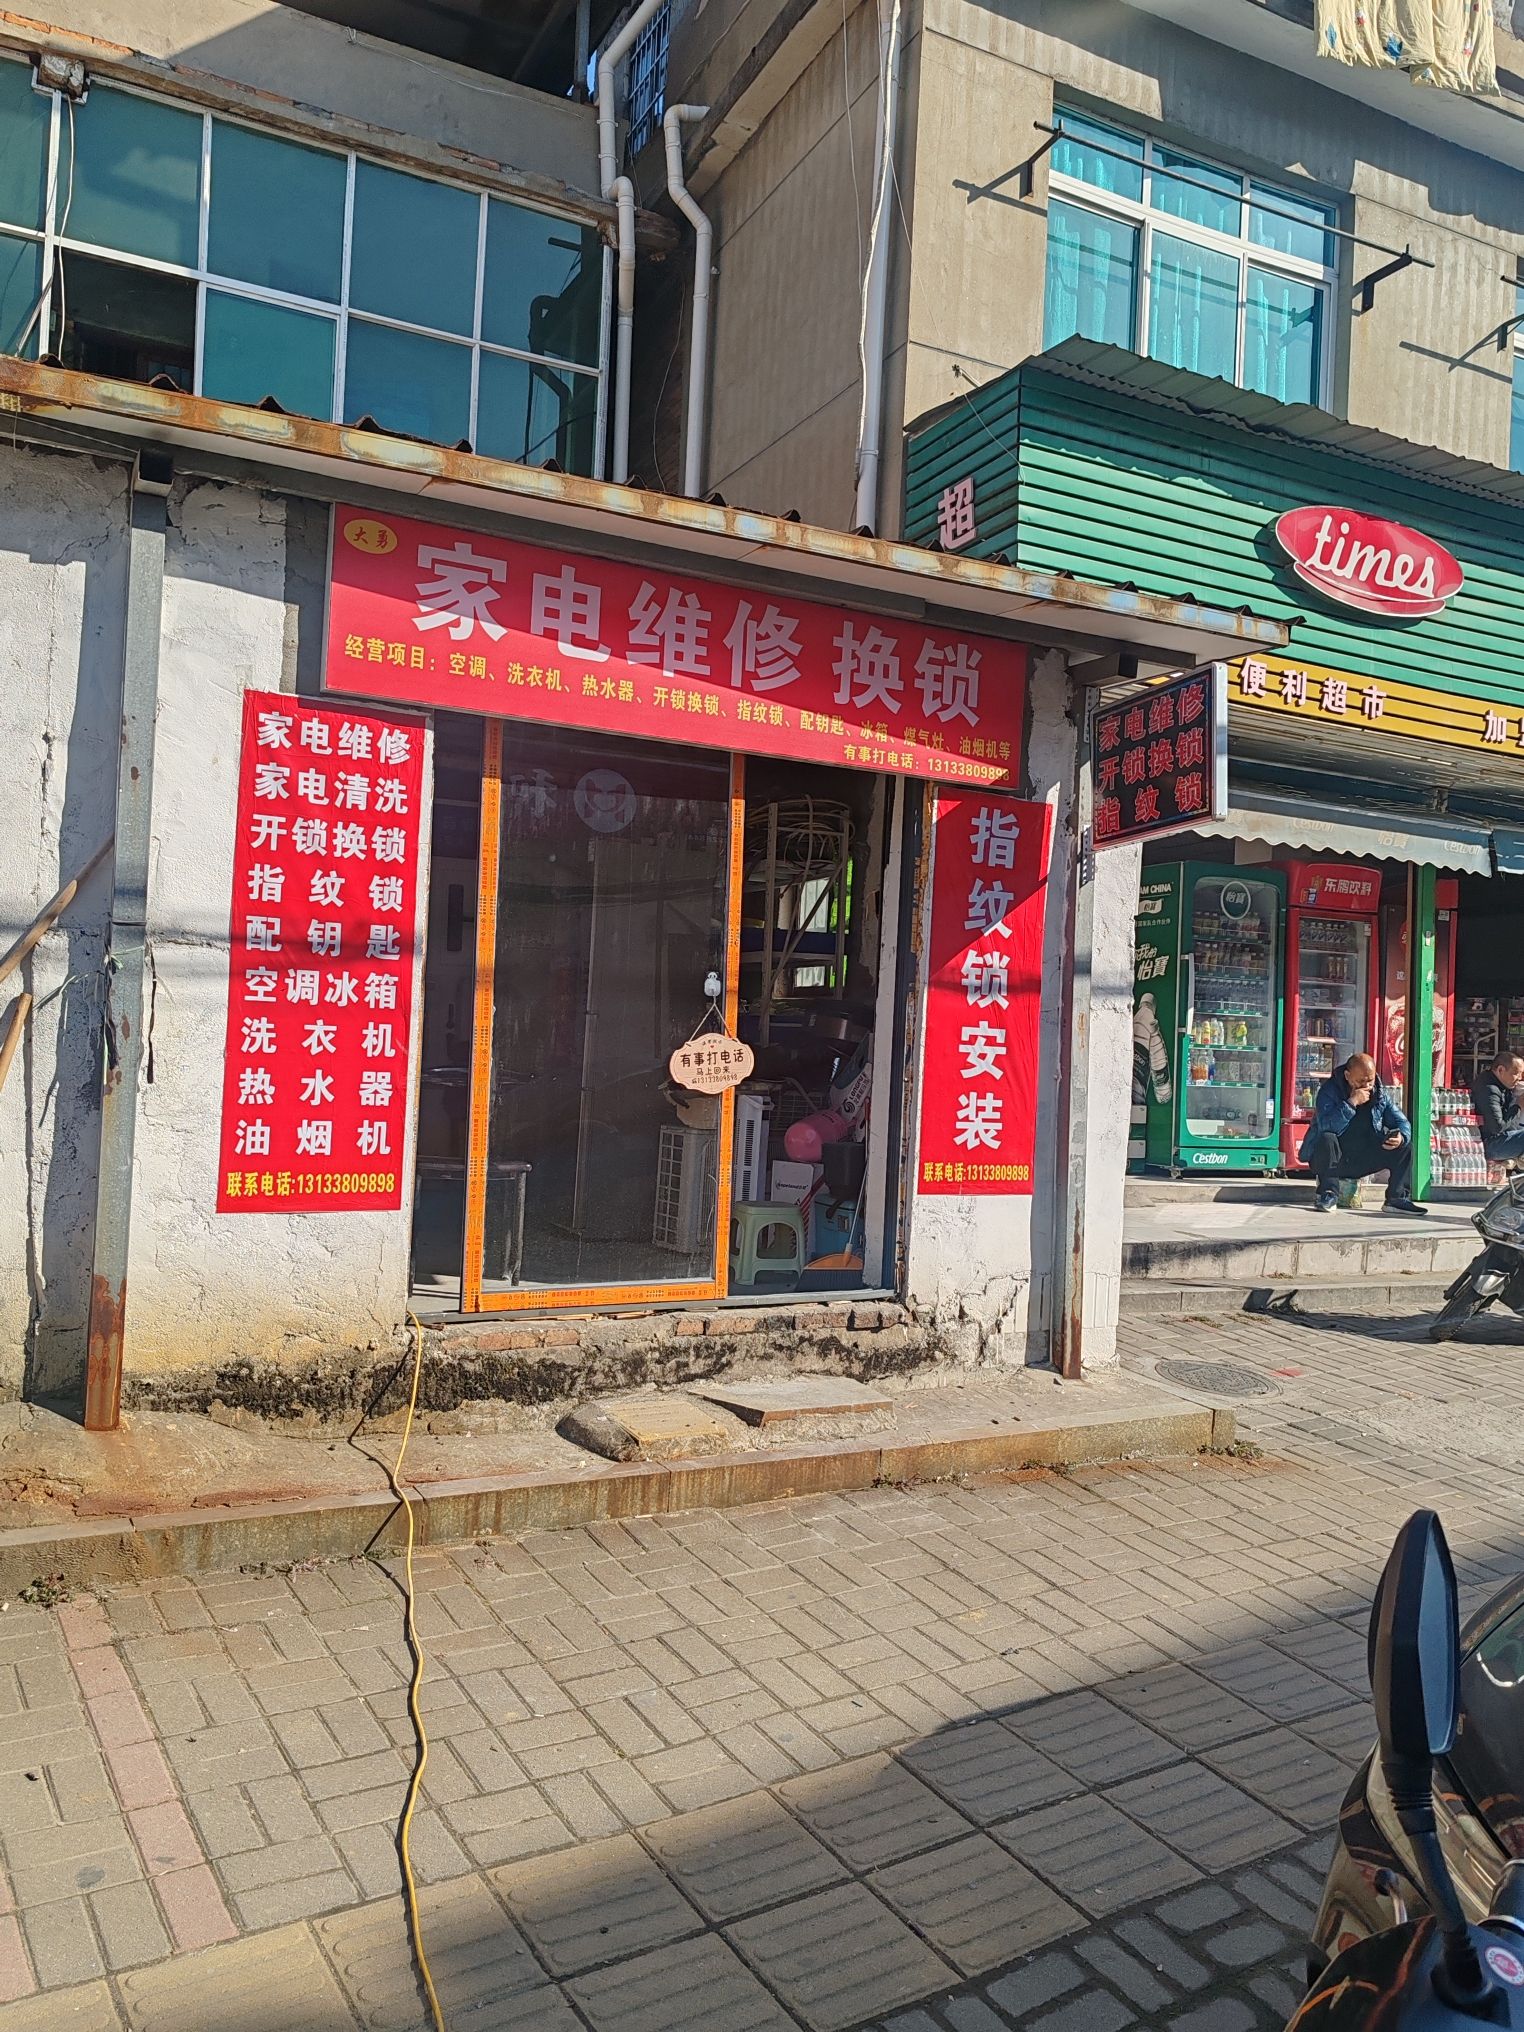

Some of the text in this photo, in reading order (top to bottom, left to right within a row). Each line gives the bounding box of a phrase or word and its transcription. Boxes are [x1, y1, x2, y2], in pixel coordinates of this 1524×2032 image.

[938, 477, 975, 549] 超
[1305, 515, 1435, 598] times
[1099, 683, 1205, 751] 家电维修
[1240, 656, 1524, 747] 便利超市 加
[256, 711, 411, 765] 家电维修
[1099, 727, 1204, 792] 开锁换锁
[253, 762, 408, 814] 家电清洗
[250, 814, 407, 864] 开锁换锁
[247, 863, 404, 912] 指纹锁
[1150, 883, 1172, 894] CHINA
[245, 915, 401, 960] 配钥匙
[244, 966, 399, 1010] 空调冰箱
[953, 806, 1020, 1151] 指纹锁安装
[240, 1016, 396, 1058] 洗衣机
[680, 1048, 744, 1068] 有事打电话
[237, 1067, 393, 1107] 热水器
[696, 1065, 730, 1076] 马上回来
[234, 1118, 392, 1156] 油烟机
